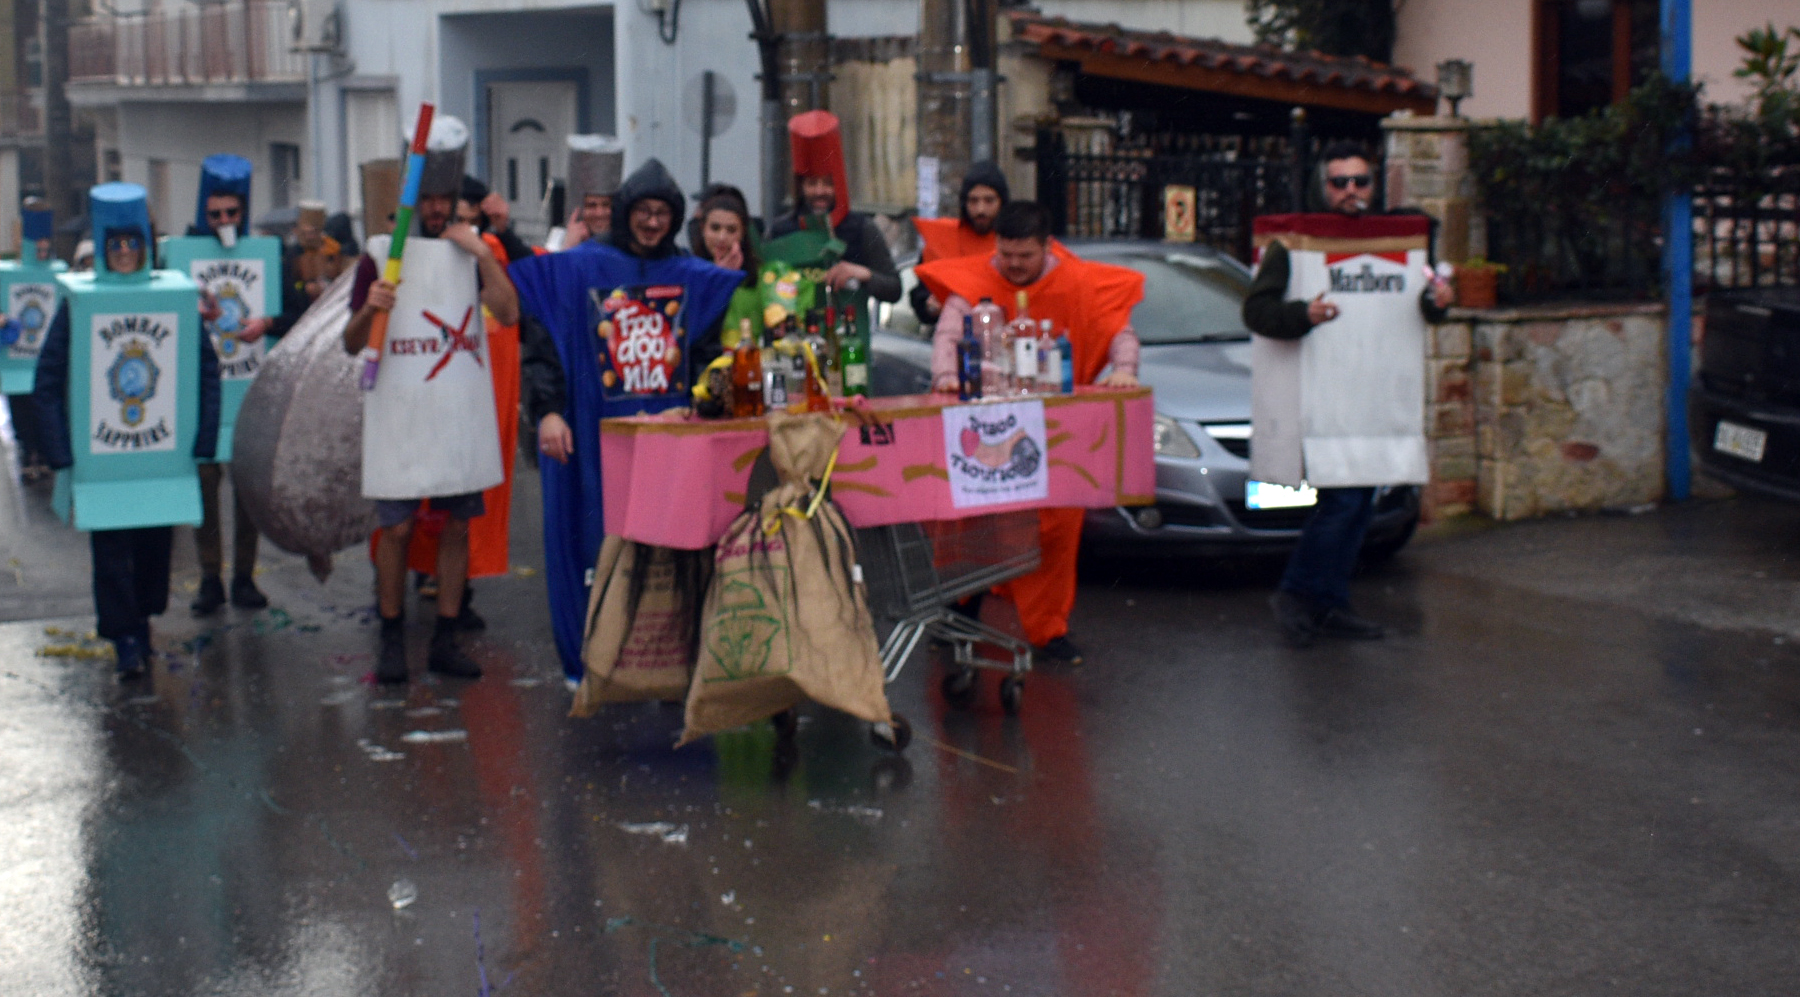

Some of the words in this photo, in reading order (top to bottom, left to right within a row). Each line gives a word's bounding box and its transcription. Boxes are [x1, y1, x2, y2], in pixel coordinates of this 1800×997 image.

[1330, 264, 1405, 292] Marlboro
[99, 316, 169, 349] BOMBAY
[96, 418, 170, 449] SAPPHIRE
